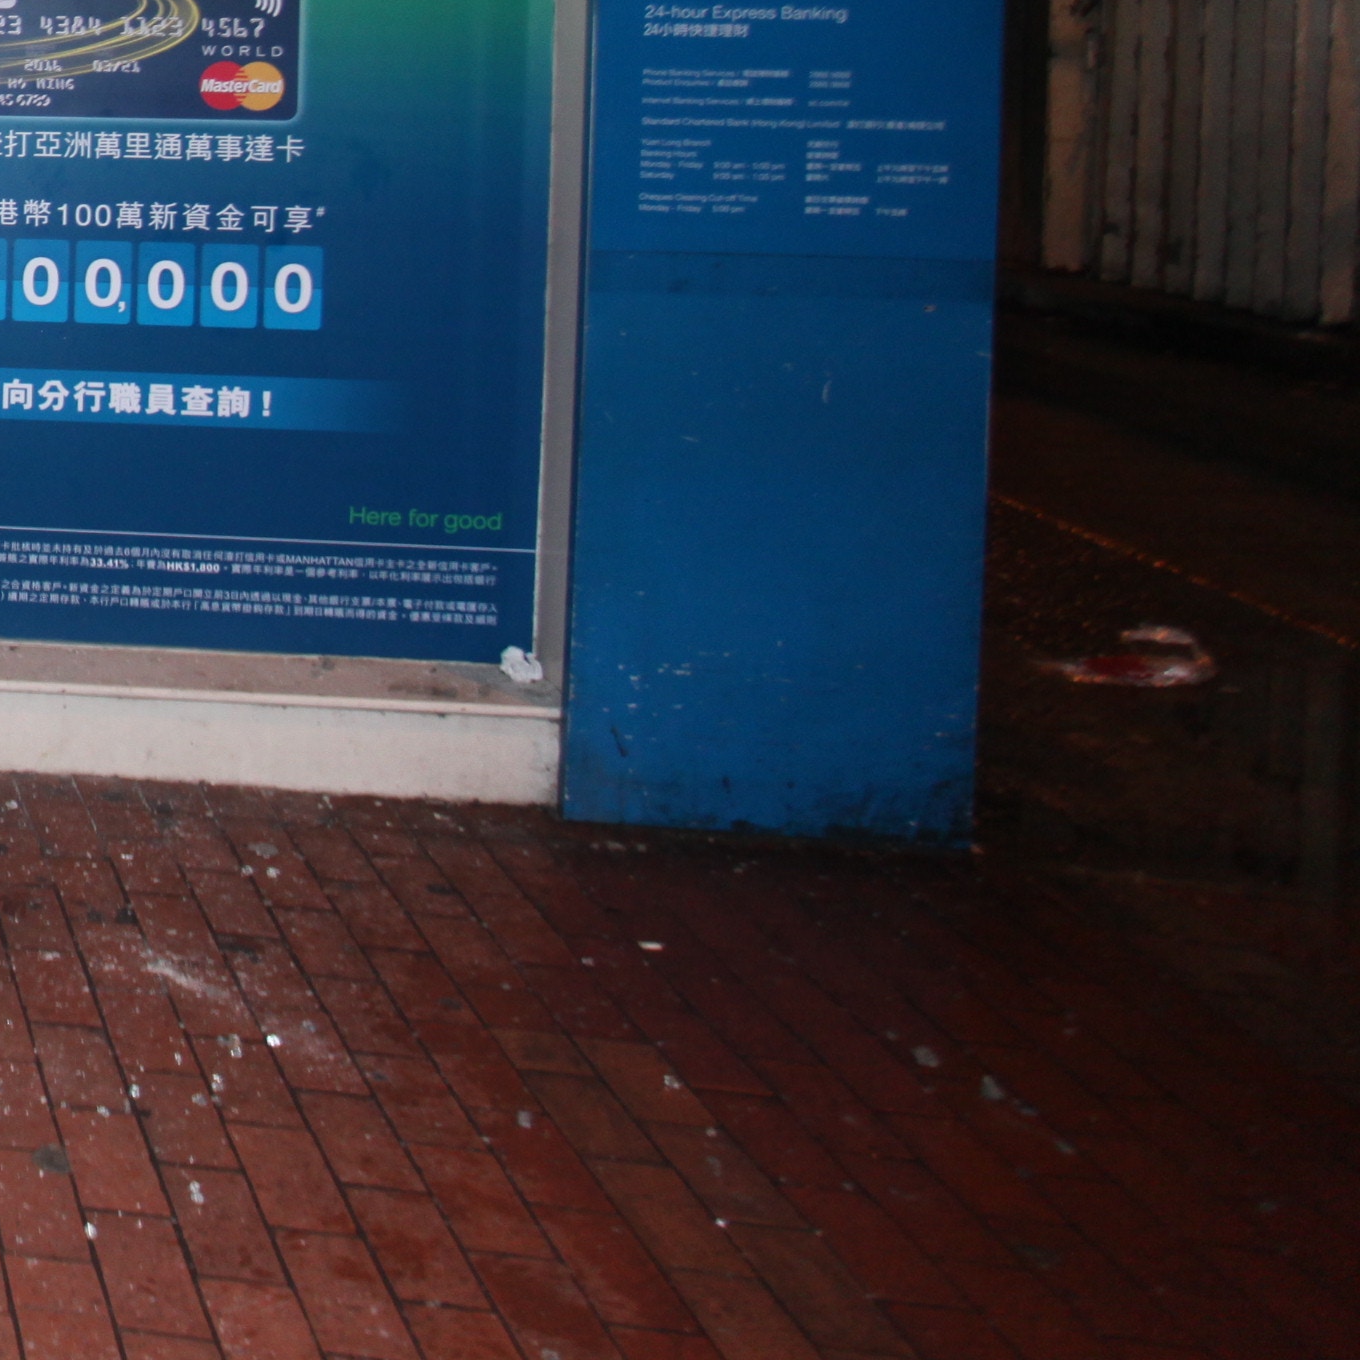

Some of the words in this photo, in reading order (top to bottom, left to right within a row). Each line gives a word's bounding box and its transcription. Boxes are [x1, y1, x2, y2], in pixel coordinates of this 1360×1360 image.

[644, 5, 709, 19] 24-hour
[712, 5, 777, 22] Express
[781, 6, 849, 24] Banking
[201, 17, 266, 38] 4567
[201, 45, 284, 57] WORLD
[200, 78, 283, 93] MasterCard
[349, 506, 402, 529] Here
[407, 506, 437, 529] for
[443, 510, 503, 533] good
